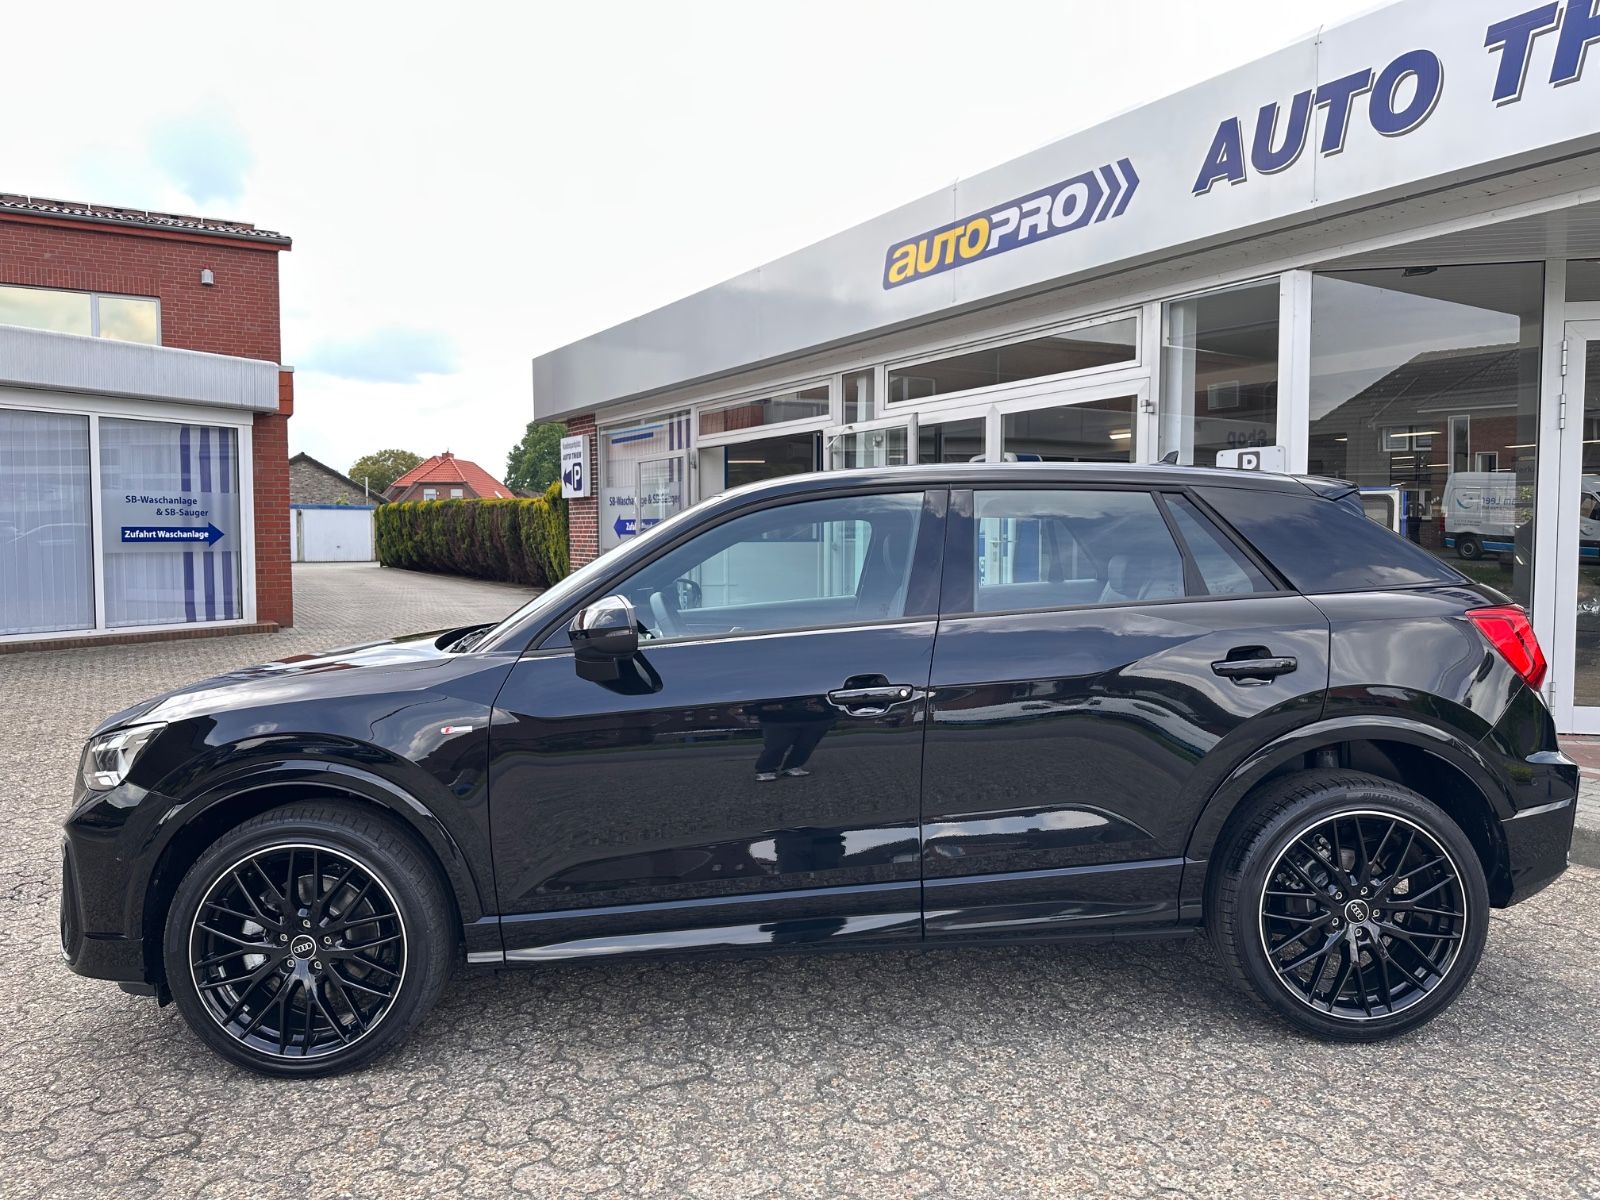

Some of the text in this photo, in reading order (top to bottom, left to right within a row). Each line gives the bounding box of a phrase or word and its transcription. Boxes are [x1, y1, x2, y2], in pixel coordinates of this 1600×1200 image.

[1191, 49, 1444, 197] AUTO
[1242, 454, 1258, 469] P
[573, 465, 581, 489] P
[125, 495, 198, 507] SB-Waschanlage
[156, 508, 209, 518] & SB-Sauger
[124, 530, 209, 540] Zufahrt Waschanlage
